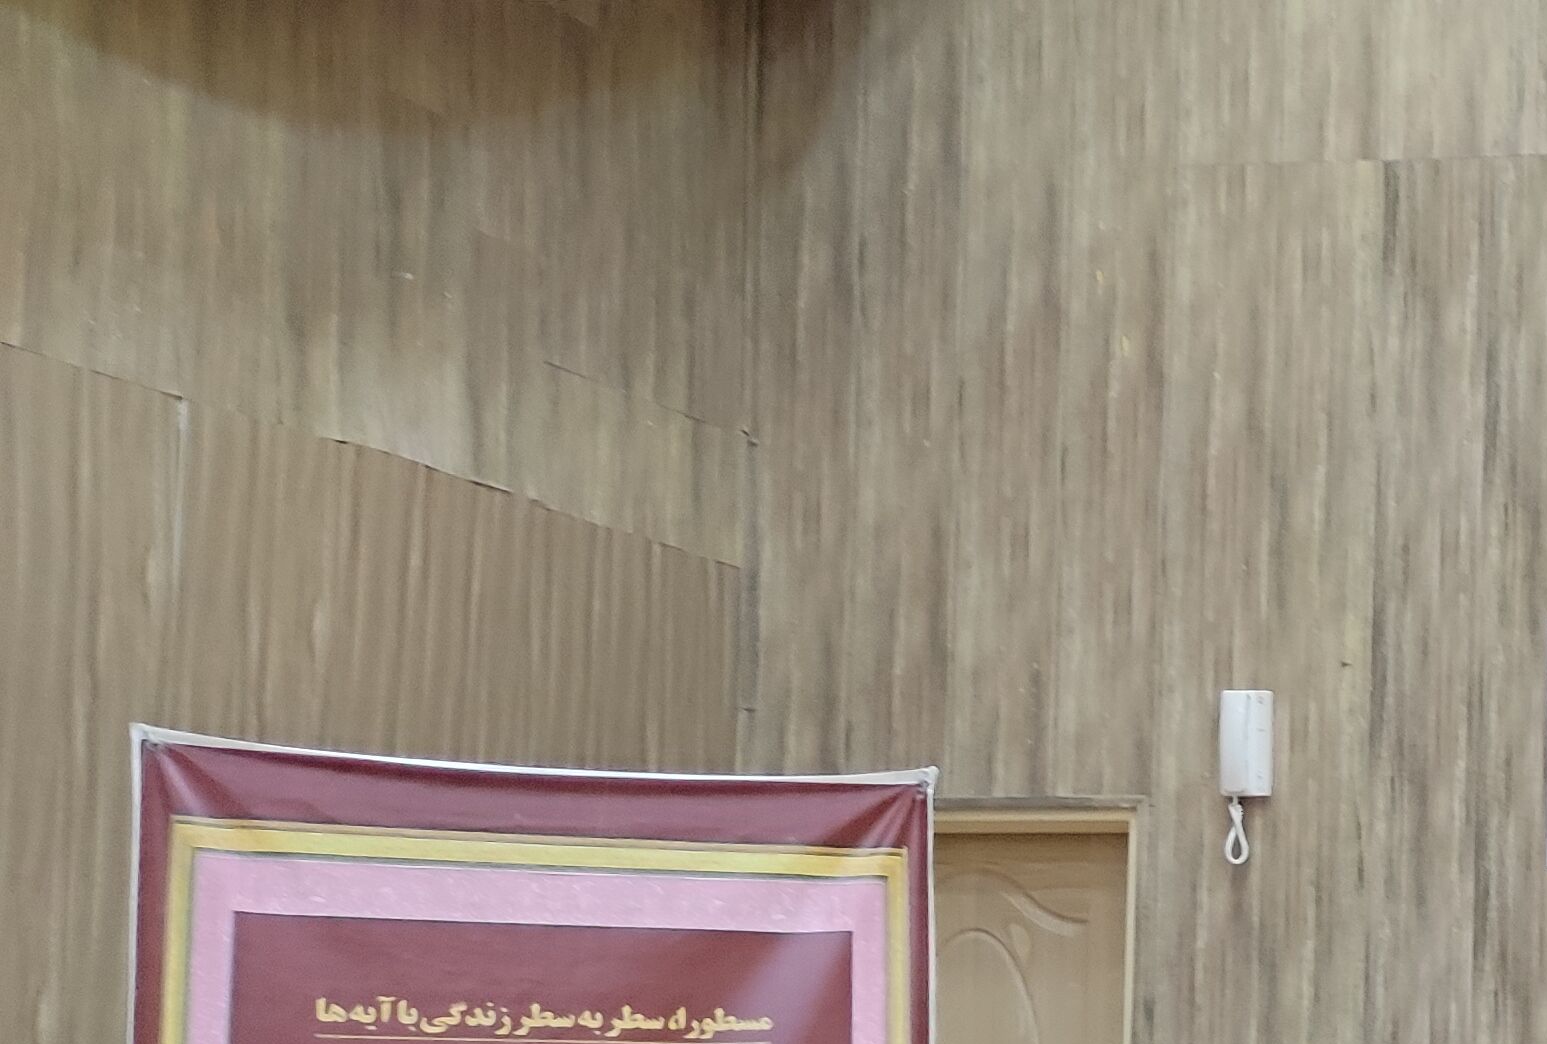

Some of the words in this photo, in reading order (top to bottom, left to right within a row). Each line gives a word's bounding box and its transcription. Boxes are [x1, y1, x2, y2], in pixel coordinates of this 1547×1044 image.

[396, 998, 419, 1032] با
[419, 1000, 511, 1035] زندگی
[513, 1003, 575, 1036] سطر
[577, 1009, 604, 1033] به
[603, 1004, 665, 1037] سطر
